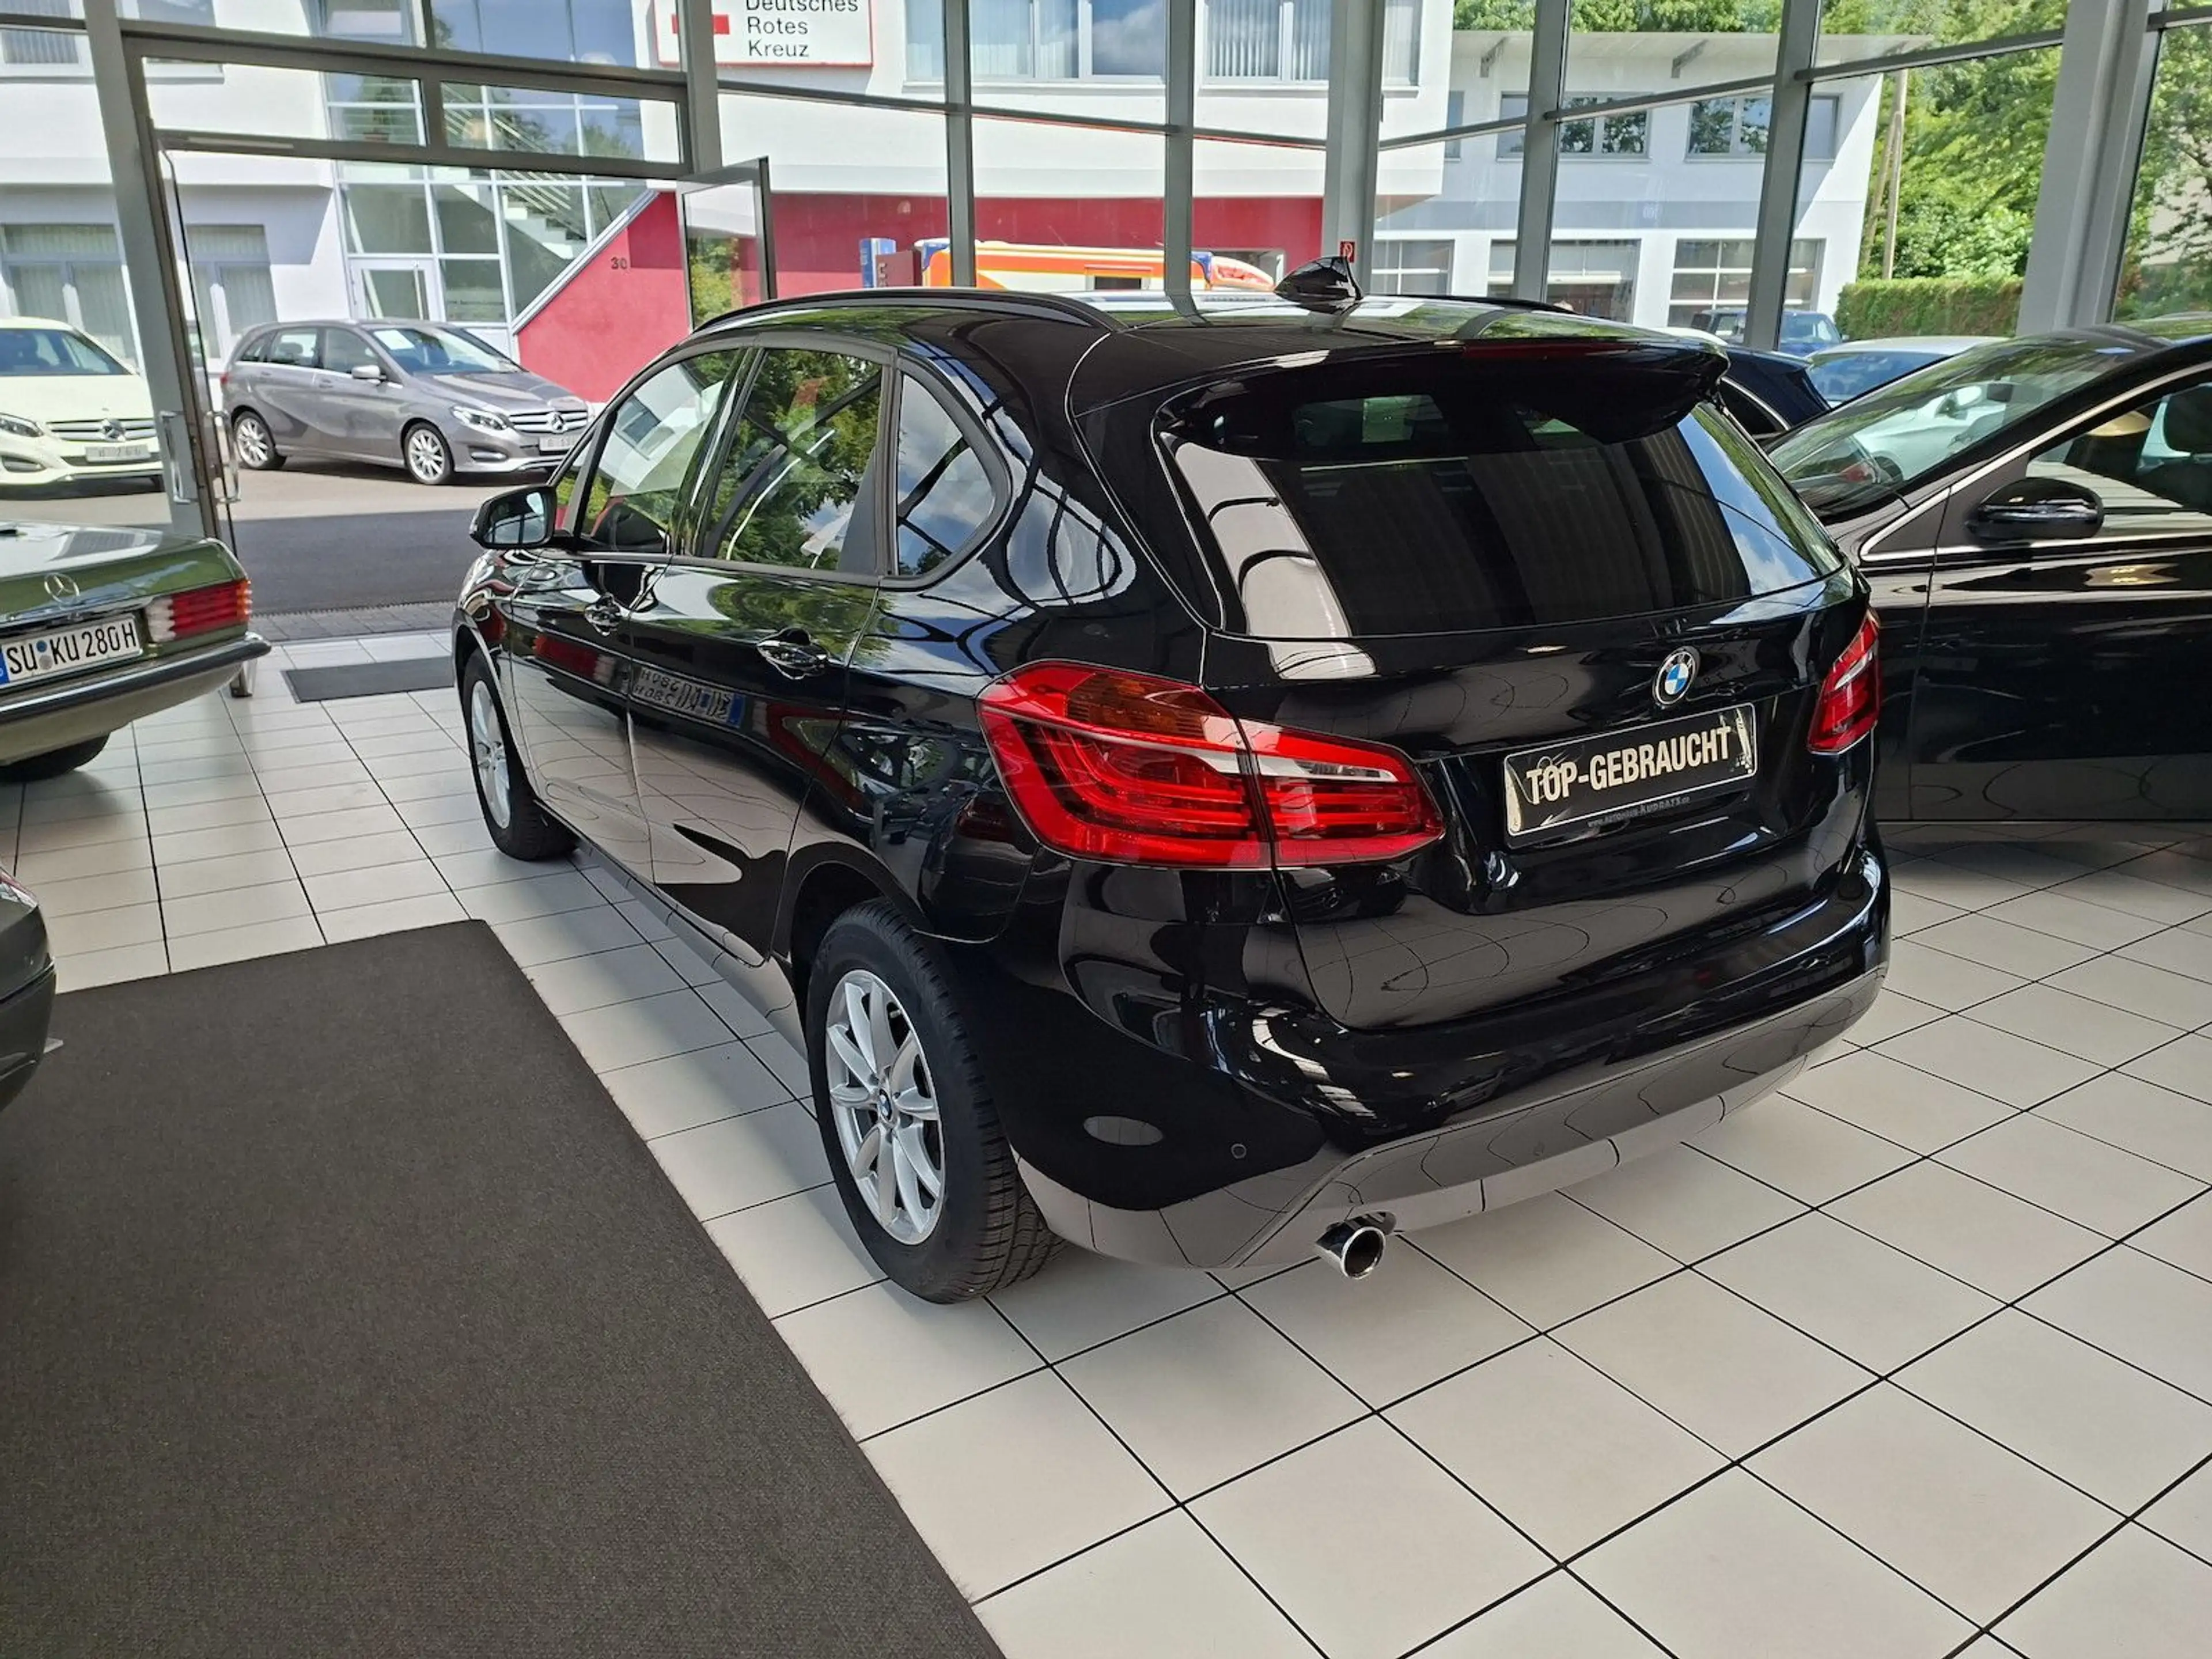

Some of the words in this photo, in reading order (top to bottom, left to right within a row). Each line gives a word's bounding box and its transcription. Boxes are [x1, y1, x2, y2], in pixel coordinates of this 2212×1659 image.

[746, 0, 858, 12] Deutsches
[748, 16, 809, 35] Rotes
[748, 40, 809, 58] Kreuz
[611, 257, 627, 270] 30
[7, 645, 38, 675] SU
[50, 635, 81, 665] KU
[1527, 725, 1732, 804] TOP-GEBRAUCHT
